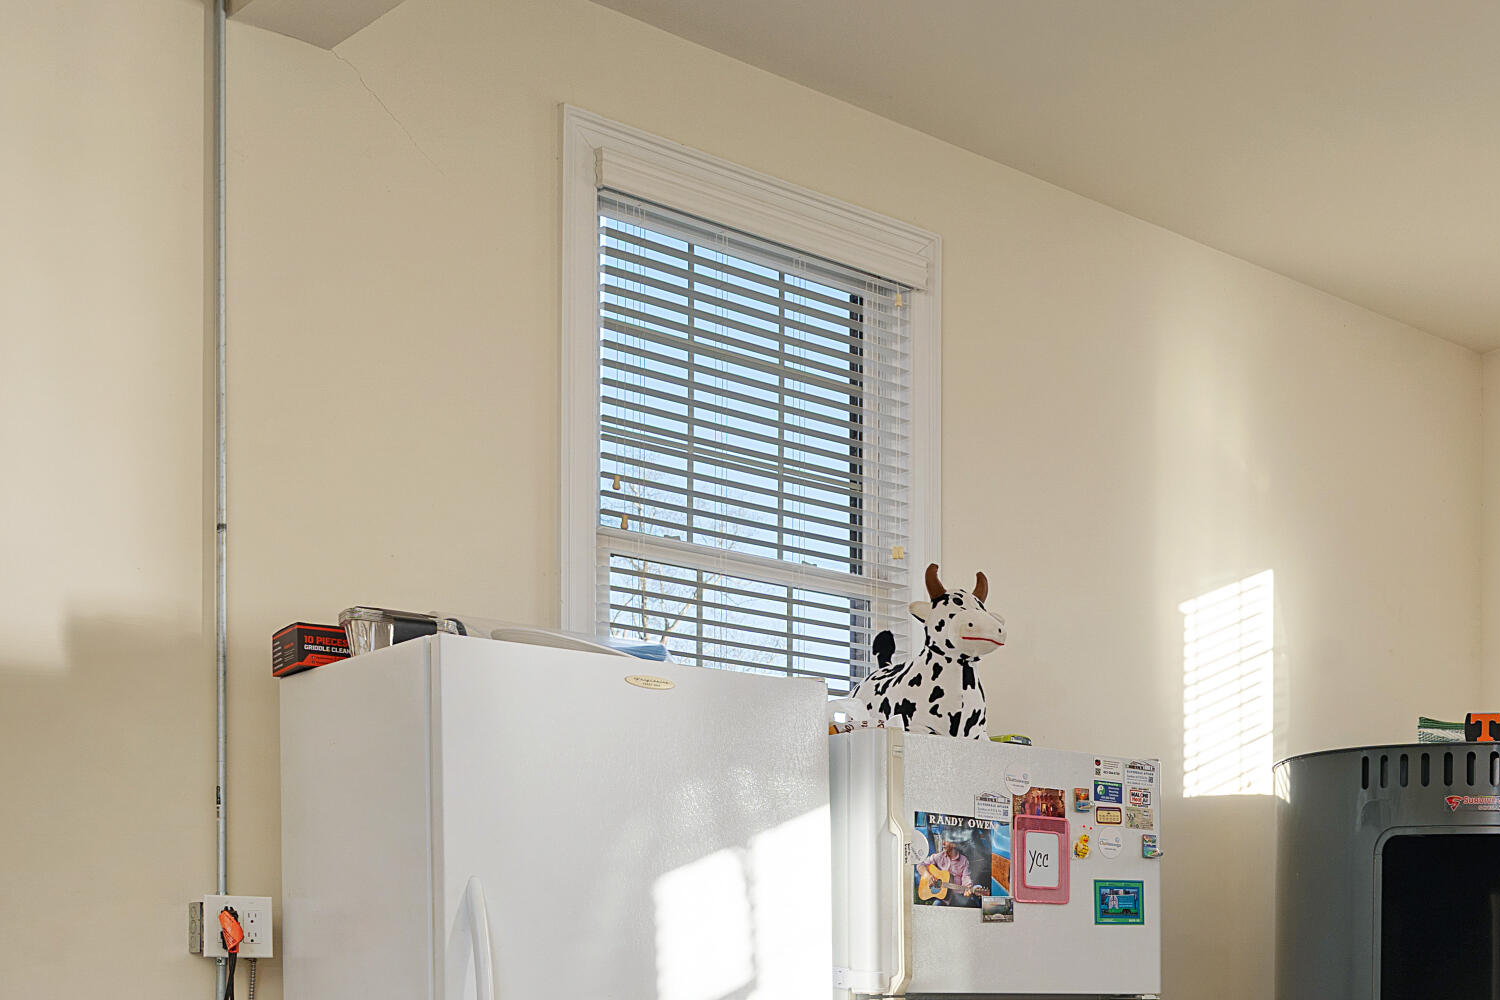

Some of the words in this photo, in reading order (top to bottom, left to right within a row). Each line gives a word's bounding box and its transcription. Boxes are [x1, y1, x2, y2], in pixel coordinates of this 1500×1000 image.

[304, 635, 314, 644] 10
[316, 637, 349, 647] PIECES
[304, 644, 330, 652] GRIDDLE
[1471, 713, 1500, 742] T
[929, 815, 964, 827] RANDY
[967, 819, 998, 830] OWEN
